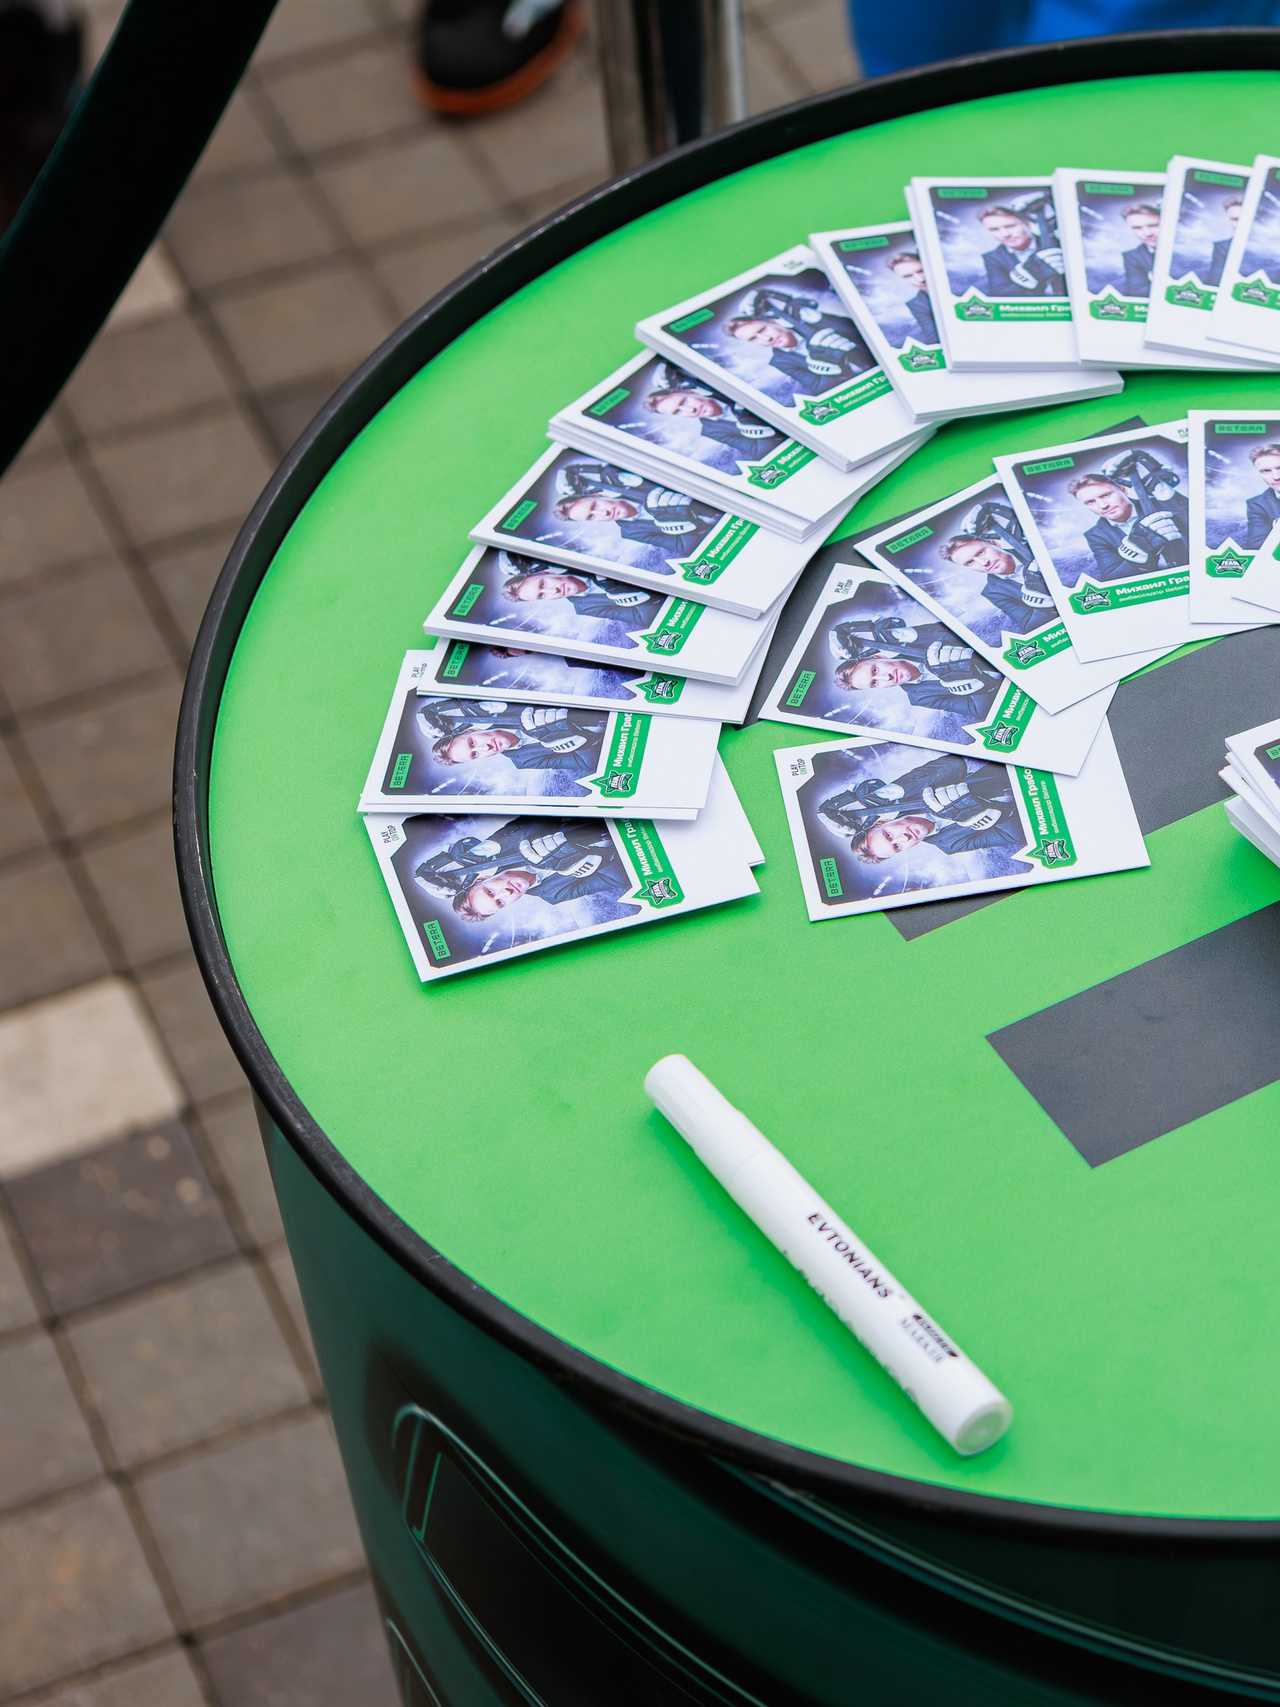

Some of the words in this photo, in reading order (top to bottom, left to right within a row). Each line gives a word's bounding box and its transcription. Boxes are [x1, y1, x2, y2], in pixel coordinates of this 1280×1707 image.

[706, 529, 736, 558] Михаил
[1115, 580, 1167, 596] Михаил
[666, 600, 688, 628] Михаи
[1042, 627, 1067, 643] Мих
[447, 644, 467, 675] BETERA
[790, 672, 813, 705] BETERA
[1002, 688, 1022, 719] Михаи
[612, 732, 629, 767] Михаил
[393, 755, 409, 787] BETERA
[790, 763, 800, 777] PLAY
[1031, 797, 1049, 836] Михаил
[380, 830, 392, 845] PLAY
[631, 838, 653, 877] Михаил
[824, 860, 839, 895] BETERA
[427, 922, 447, 957] BETERA
[806, 1212, 893, 1299] EVTONIANS
